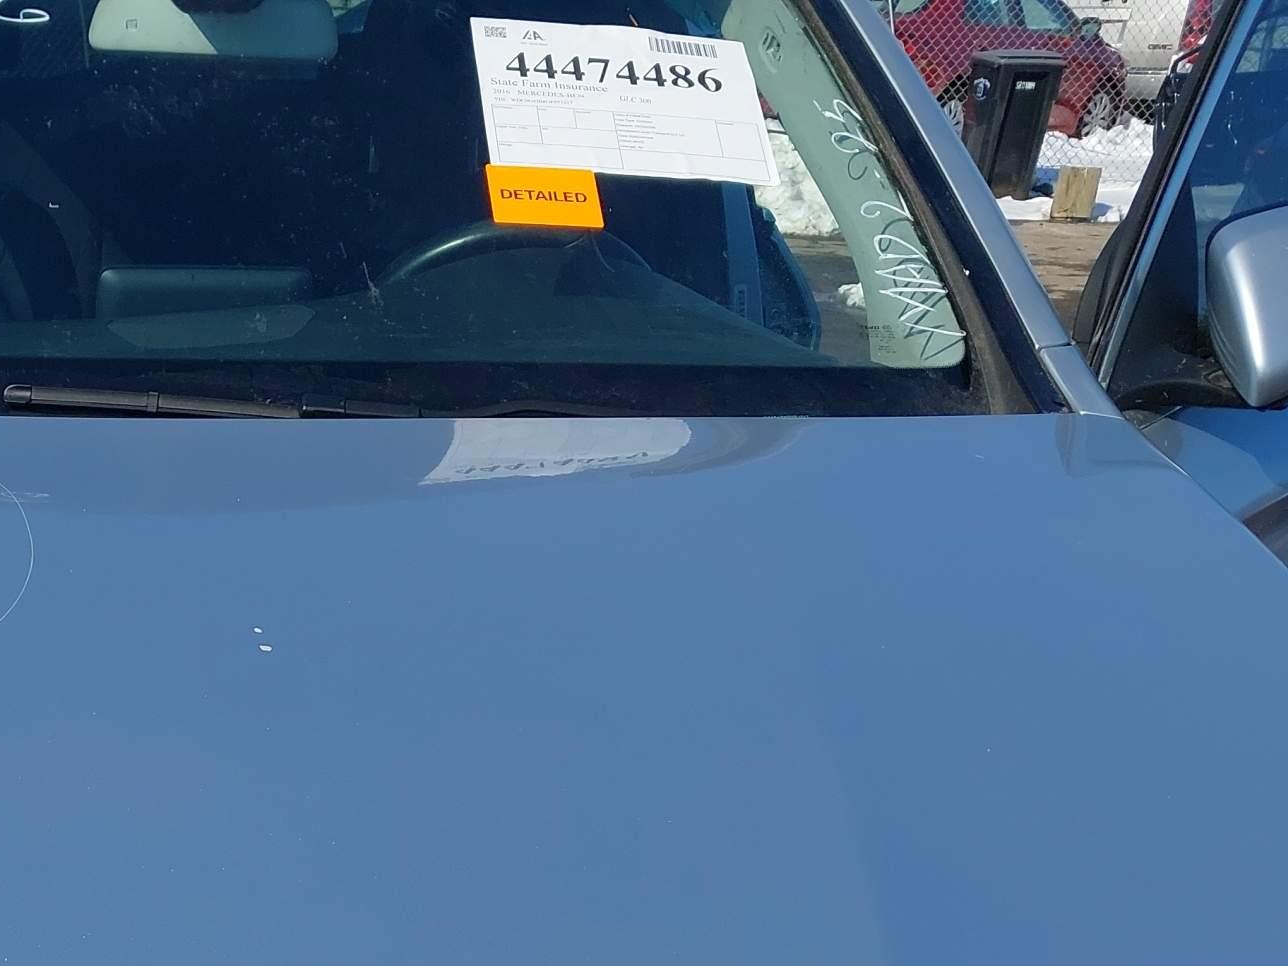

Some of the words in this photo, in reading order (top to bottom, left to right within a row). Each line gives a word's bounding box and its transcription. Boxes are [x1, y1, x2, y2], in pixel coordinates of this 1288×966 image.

[505, 51, 723, 93] 44474486
[490, 77, 518, 87] State
[522, 79, 551, 90] Farm
[554, 80, 609, 93] Insurance
[500, 187, 588, 203] DETAILED
